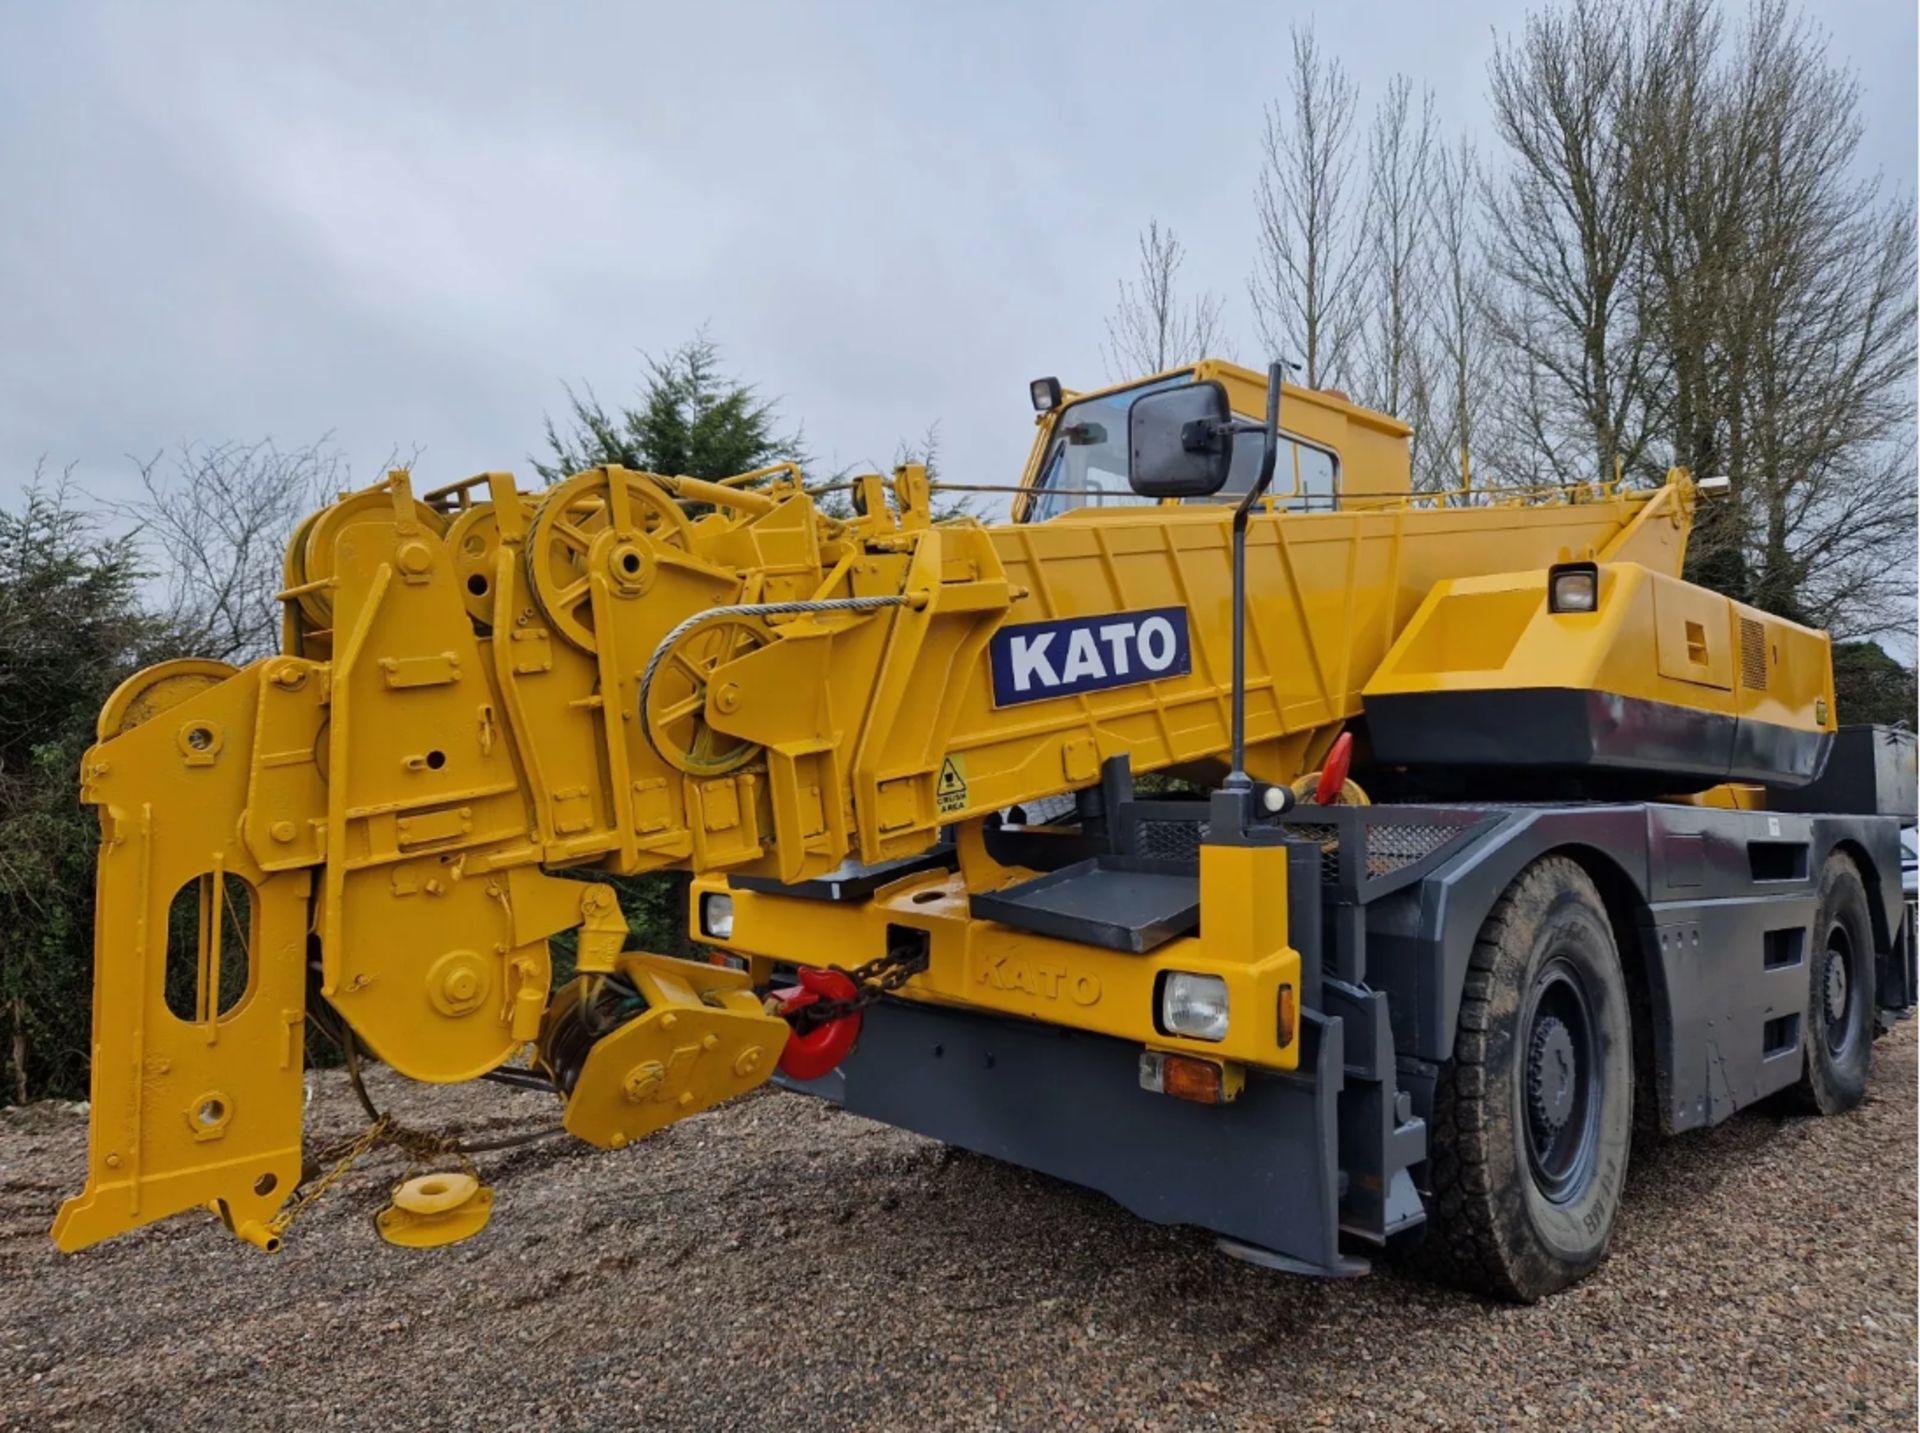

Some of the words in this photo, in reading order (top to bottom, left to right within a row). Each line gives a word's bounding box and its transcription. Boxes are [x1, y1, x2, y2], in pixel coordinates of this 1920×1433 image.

[1010, 616, 1176, 691] KATO
[937, 792, 966, 805] CRUSH
[941, 802, 965, 813] AREA
[976, 953, 1103, 1007] KATO
